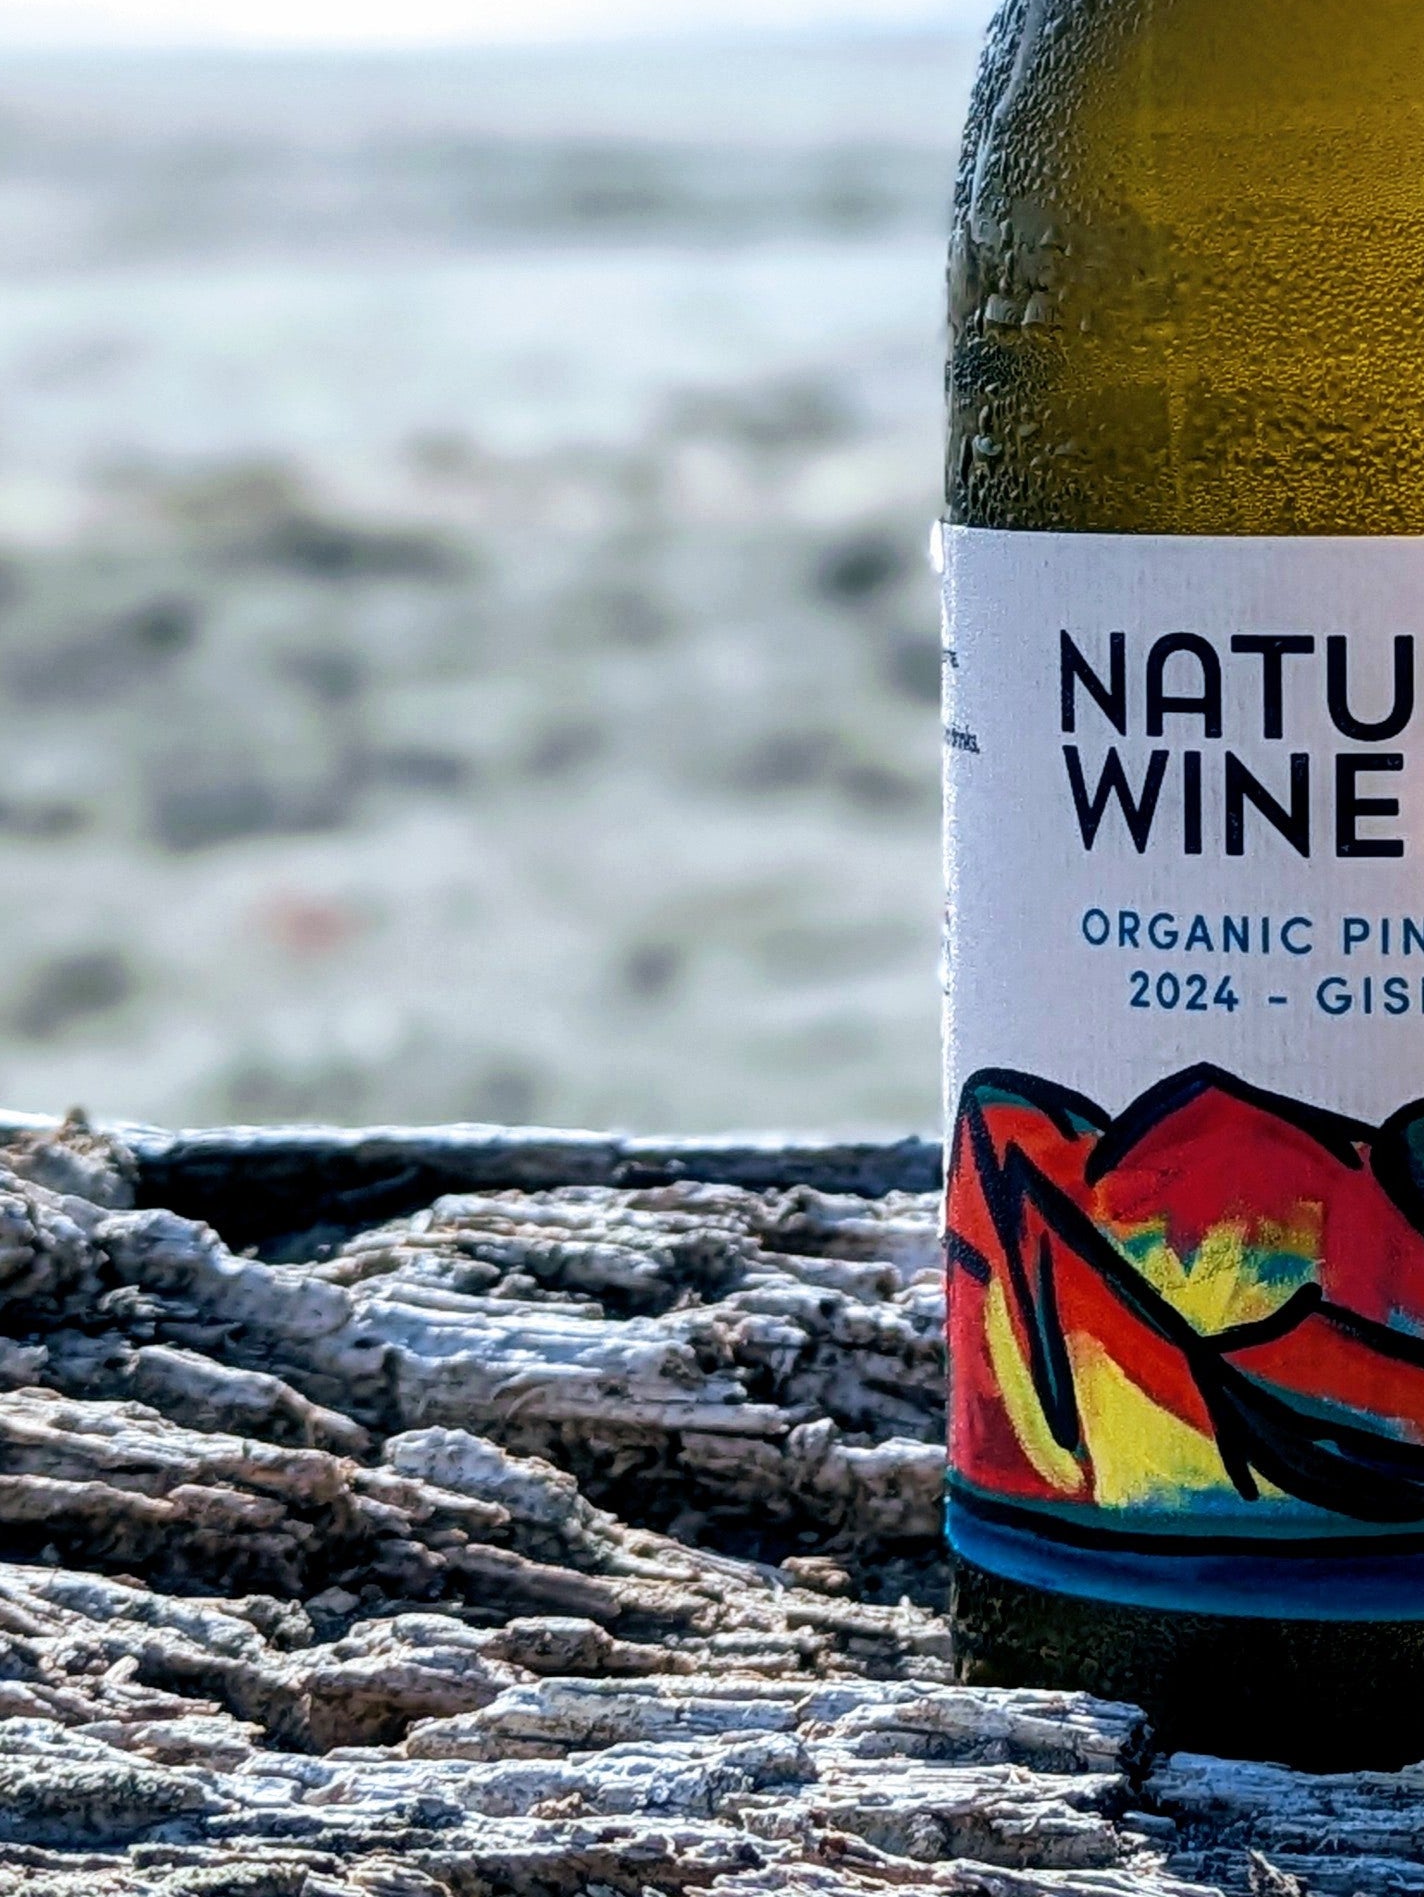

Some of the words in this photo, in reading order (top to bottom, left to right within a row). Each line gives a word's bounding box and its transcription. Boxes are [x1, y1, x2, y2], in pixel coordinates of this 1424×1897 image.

[1061, 744, 1405, 859] WINE
[1081, 907, 1315, 956] ORGANIC
[1129, 970, 1240, 1013] 2024
